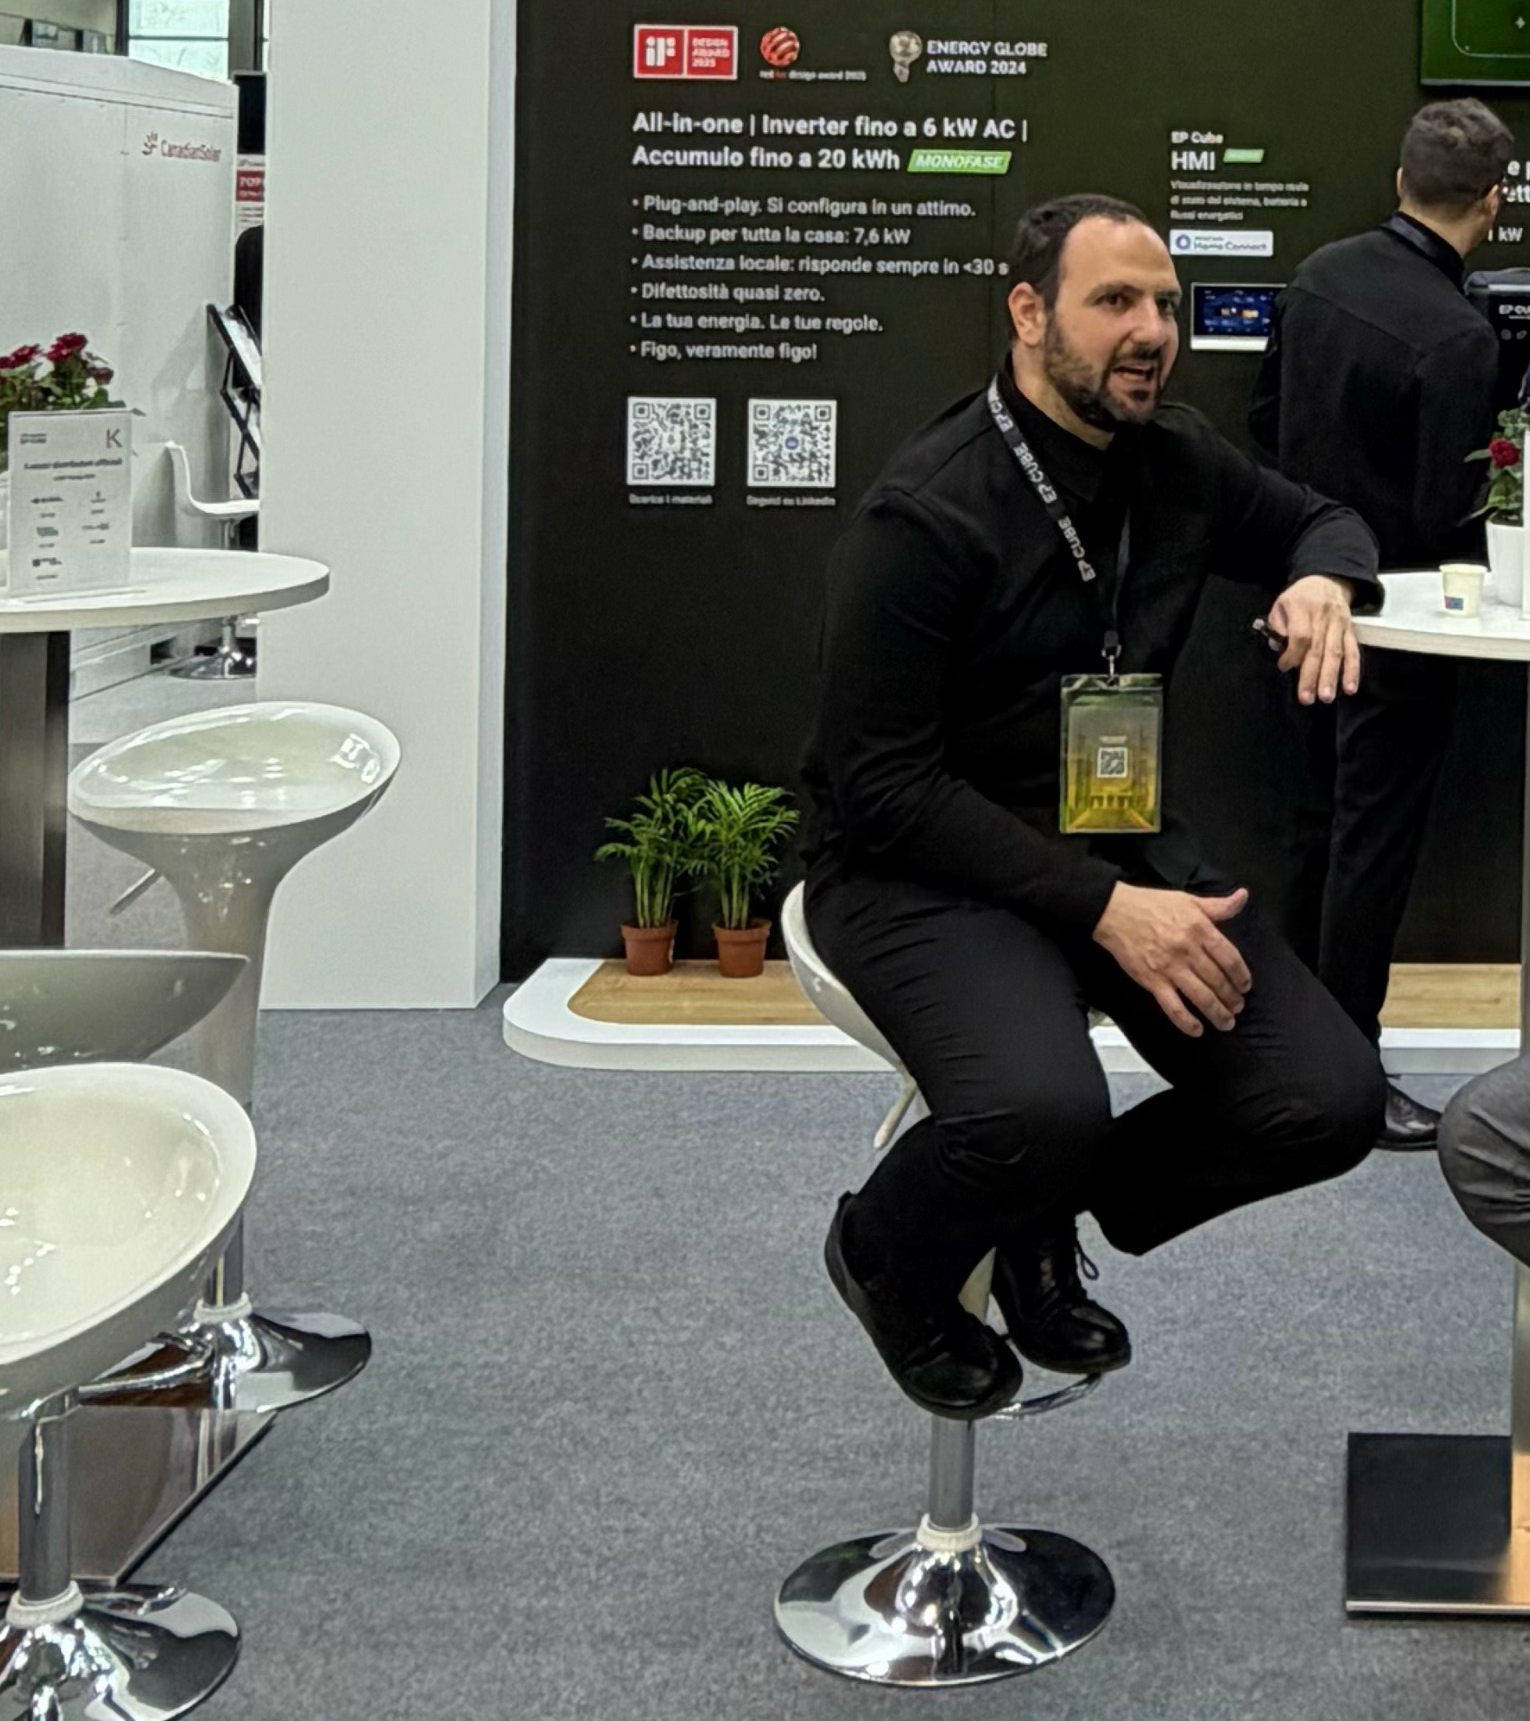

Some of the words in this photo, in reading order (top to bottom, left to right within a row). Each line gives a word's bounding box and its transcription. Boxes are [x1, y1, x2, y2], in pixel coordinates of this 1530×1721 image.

[926, 40, 992, 58] ENERGY
[994, 41, 1048, 58] GLOBE
[926, 59, 987, 75] AWARD
[990, 60, 1027, 76] 2024
[632, 112, 743, 134] All-in-one
[762, 115, 848, 137] Inverter
[855, 116, 898, 137] fino
[903, 122, 917, 137] a
[923, 119, 936, 137] 6
[943, 117, 977, 139] kW
[983, 119, 1015, 139] AC
[632, 146, 744, 167] Accumulo
[750, 147, 793, 168] fino
[798, 153, 812, 169] a
[818, 148, 847, 169] 20
[852, 148, 900, 170] kWh
[916, 154, 1003, 169] MONOFASE
[1171, 150, 1216, 171] HMI
[643, 195, 762, 217] Plug-and-play.
[767, 197, 783, 213] Si
[787, 197, 867, 218] configura
[872, 198, 887, 215] in
[891, 203, 912, 216] un
[916, 199, 976, 217] attimo.
[643, 226, 706, 245] Backup
[709, 230, 738, 245] per
[742, 227, 780, 243] tutta
[785, 227, 801, 244] la
[804, 228, 849, 244] casa:
[853, 228, 880, 247] 7,6
[883, 227, 911, 244] kW
[642, 254, 735, 272] Assistenza
[739, 255, 795, 272] locale:
[798, 257, 872, 277] risponde
[876, 260, 939, 277] sempre
[943, 259, 959, 274] in
[963, 259, 995, 275] <30
[642, 283, 729, 301] Difettosità
[733, 285, 780, 304] quasi
[783, 288, 825, 302] zero.
[641, 312, 663, 328] La
[666, 314, 693, 329] tua
[697, 314, 765, 334] energia.
[770, 314, 791, 330] Le
[794, 316, 821, 331] tue
[825, 315, 883, 335] regole.
[641, 341, 682, 361] Figo,
[685, 344, 775, 360] veramente
[779, 343, 817, 364] figo!
[1013, 440, 1046, 486] CUBE
[1036, 482, 1058, 505] EP
[1056, 515, 1087, 559] CUBE
[1076, 557, 1097, 583] EP
